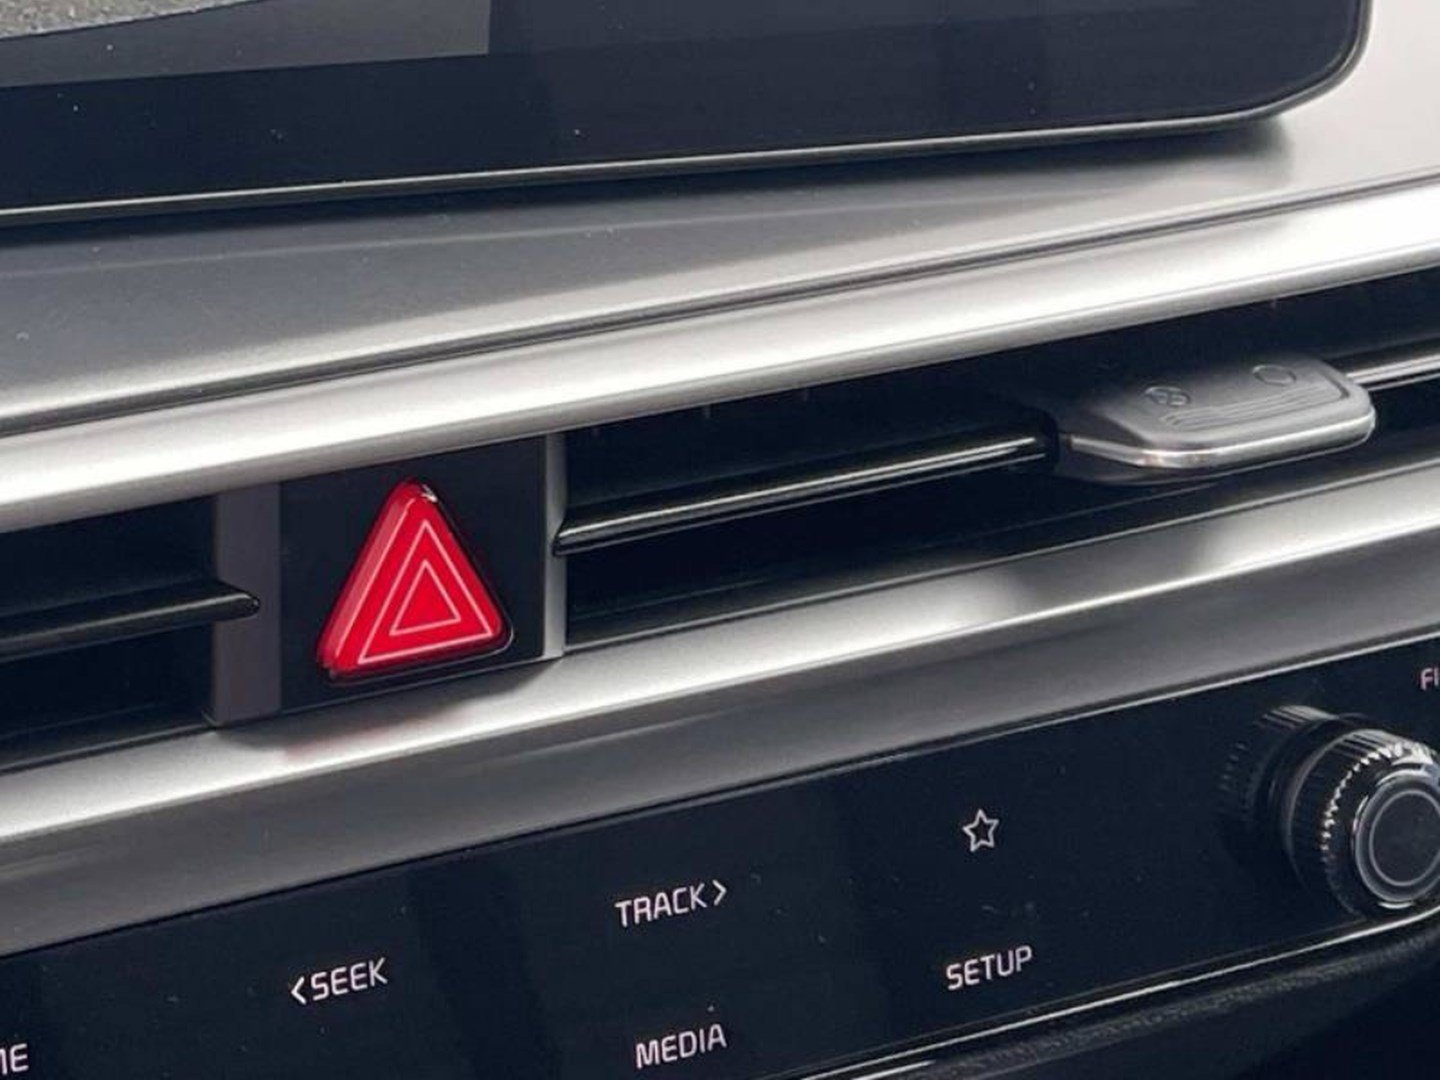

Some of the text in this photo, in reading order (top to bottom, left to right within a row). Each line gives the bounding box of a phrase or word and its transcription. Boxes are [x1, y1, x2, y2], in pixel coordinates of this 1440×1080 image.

[614, 883, 708, 928] TRACK
[310, 957, 388, 1001] SEEK
[946, 945, 1033, 991] SETUP
[635, 1023, 728, 1069] MEDIA
